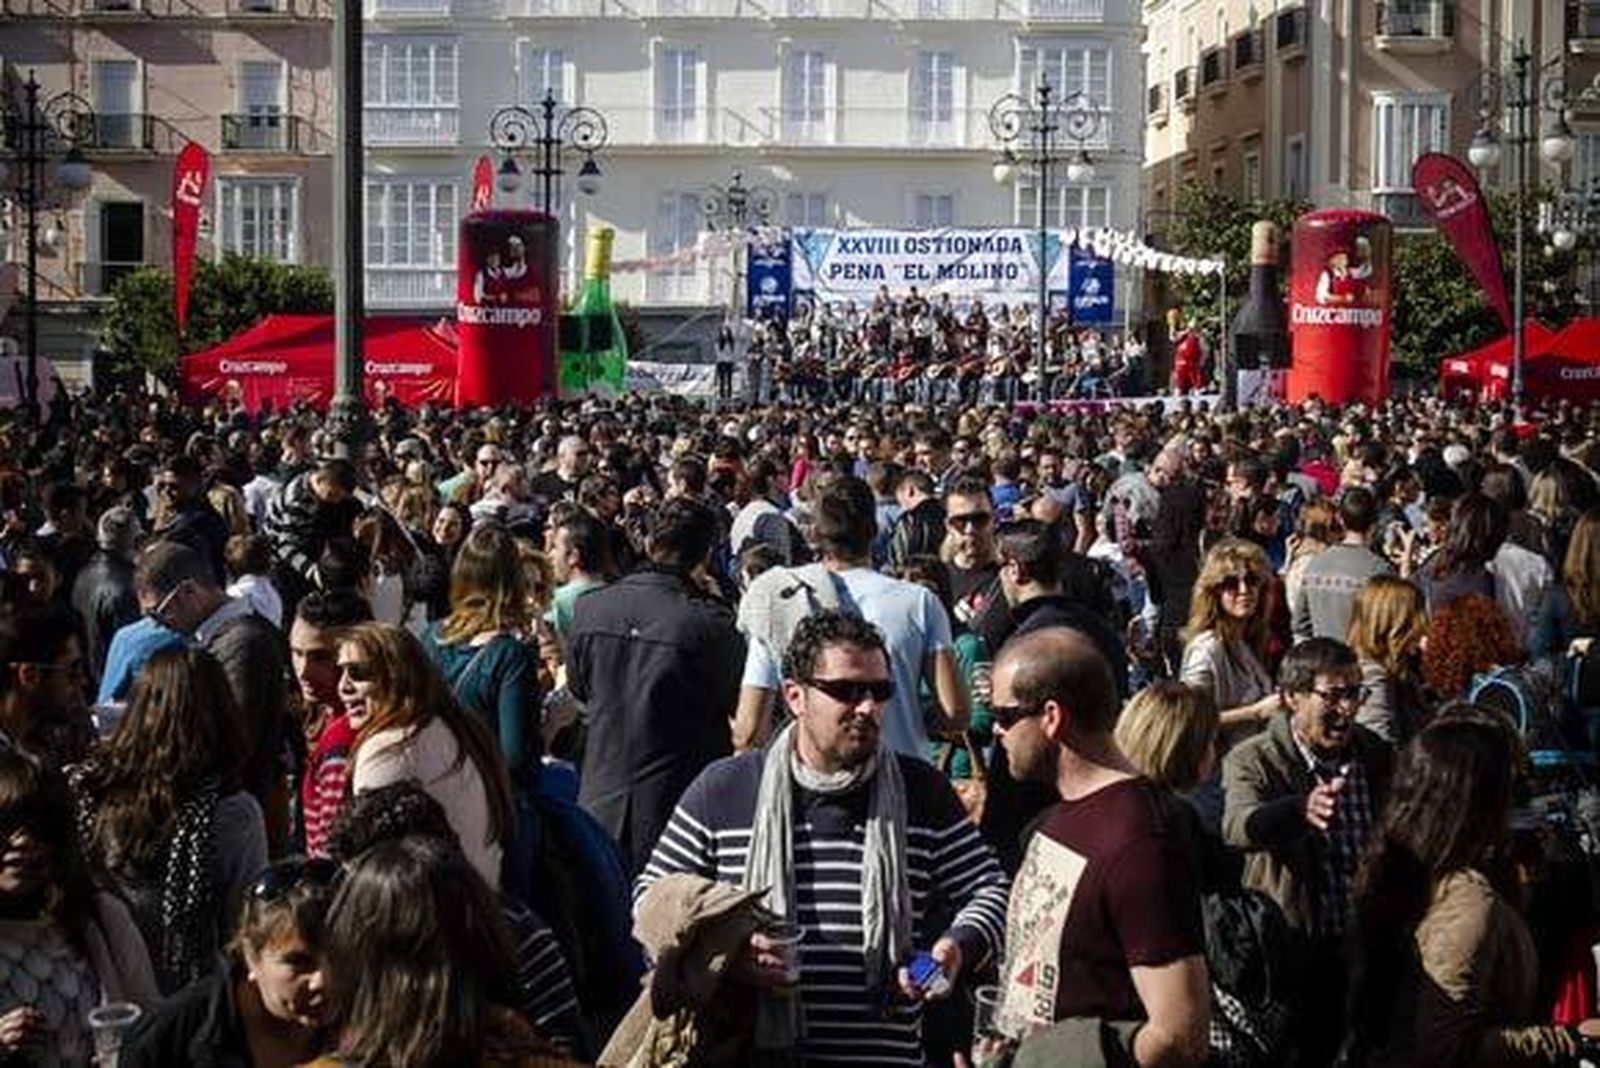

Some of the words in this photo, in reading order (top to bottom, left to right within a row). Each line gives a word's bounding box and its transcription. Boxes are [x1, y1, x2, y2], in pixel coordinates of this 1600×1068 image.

[838, 236, 899, 254] XXVIII
[904, 236, 1022, 254] OSTIONADA
[457, 303, 542, 329] Cruzcampo
[1292, 303, 1383, 329] Cruzcampo
[219, 360, 288, 376] Cruzcampo
[364, 360, 434, 376] Cruzcampo
